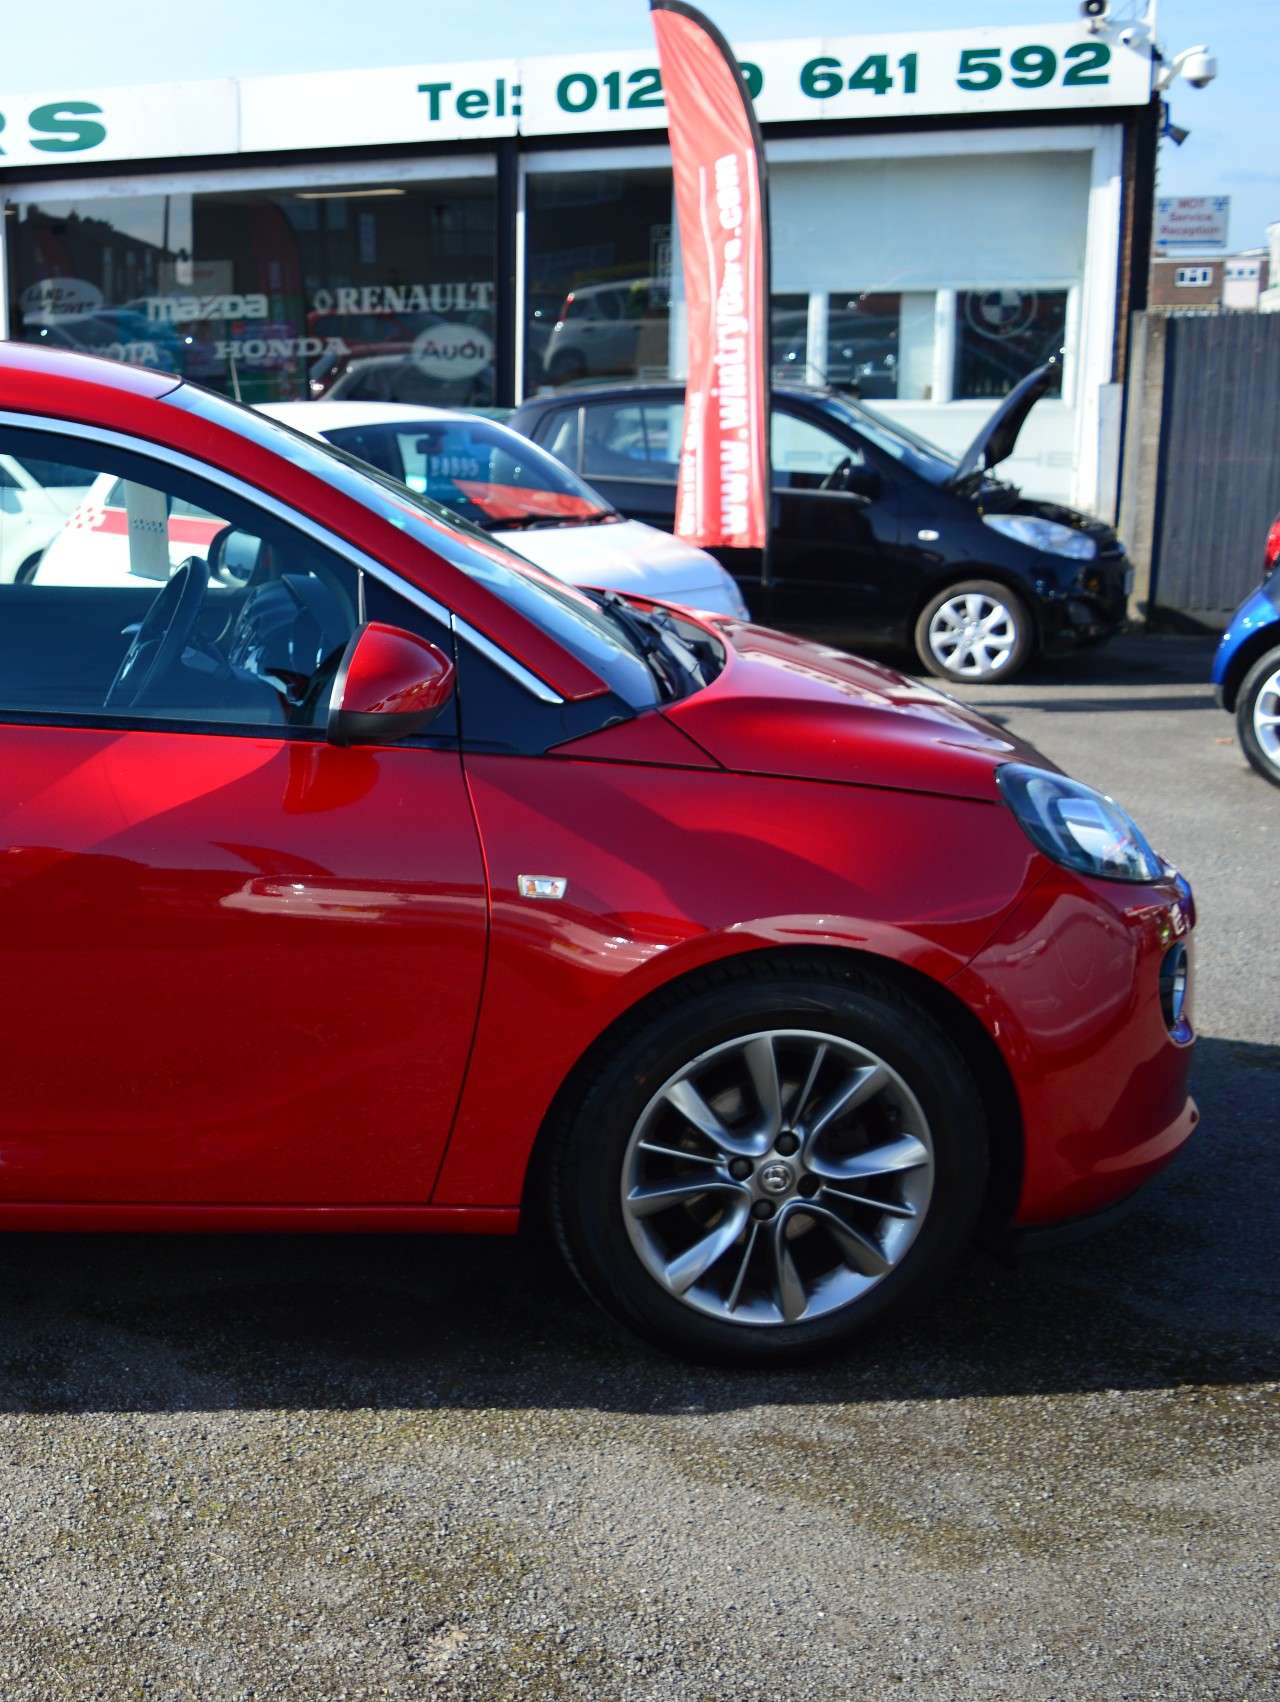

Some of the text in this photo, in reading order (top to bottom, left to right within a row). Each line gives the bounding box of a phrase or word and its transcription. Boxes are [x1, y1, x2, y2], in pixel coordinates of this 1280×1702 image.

[417, 42, 1112, 121] Tel: 0129 641 592
[335, 281, 495, 315] RENAULT
[214, 337, 353, 360] HONDA
